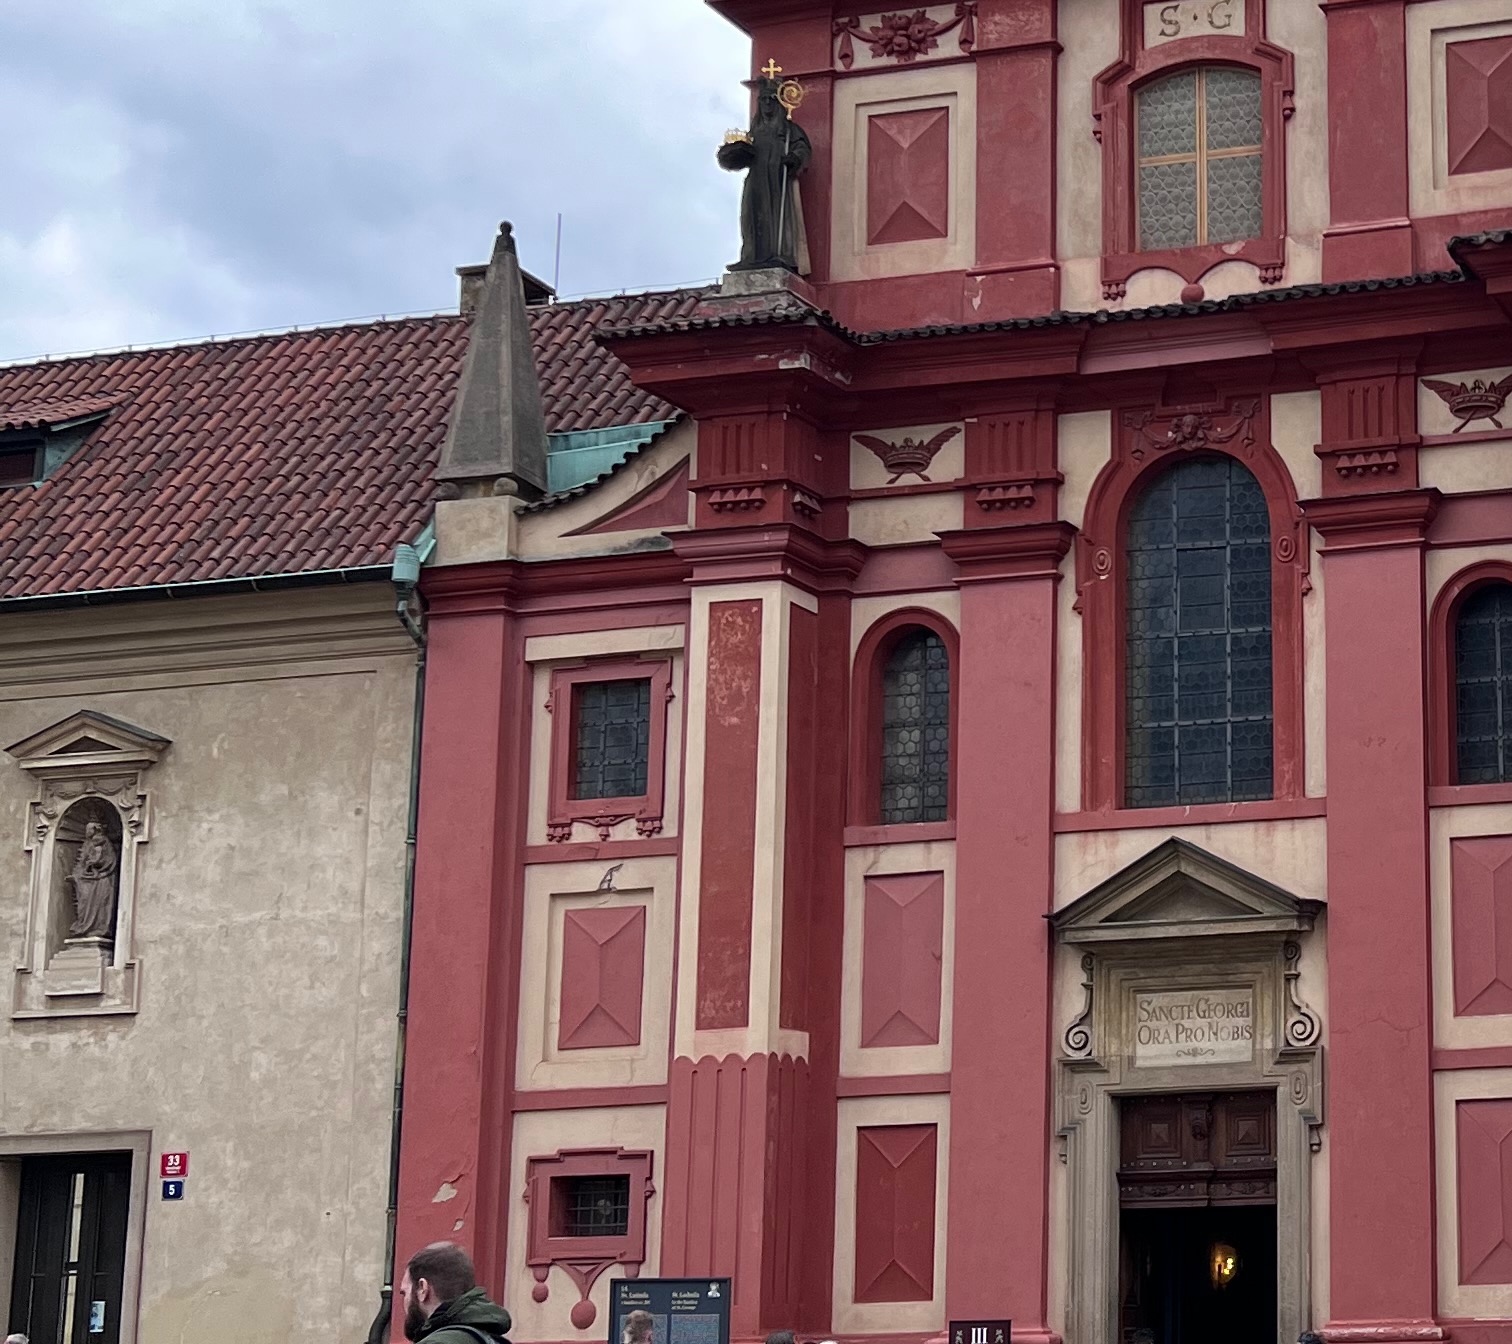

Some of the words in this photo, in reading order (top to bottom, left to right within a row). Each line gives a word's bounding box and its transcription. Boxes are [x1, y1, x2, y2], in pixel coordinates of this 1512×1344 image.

[1158, 3, 1181, 37] S
[1137, 1024, 1173, 1046] ORA
[1175, 1023, 1205, 1044] PRO
[1207, 1021, 1253, 1043] NOBIS
[167, 1154, 181, 1167] 33
[168, 1184, 176, 1196] 5
[971, 1327, 988, 1344] III
